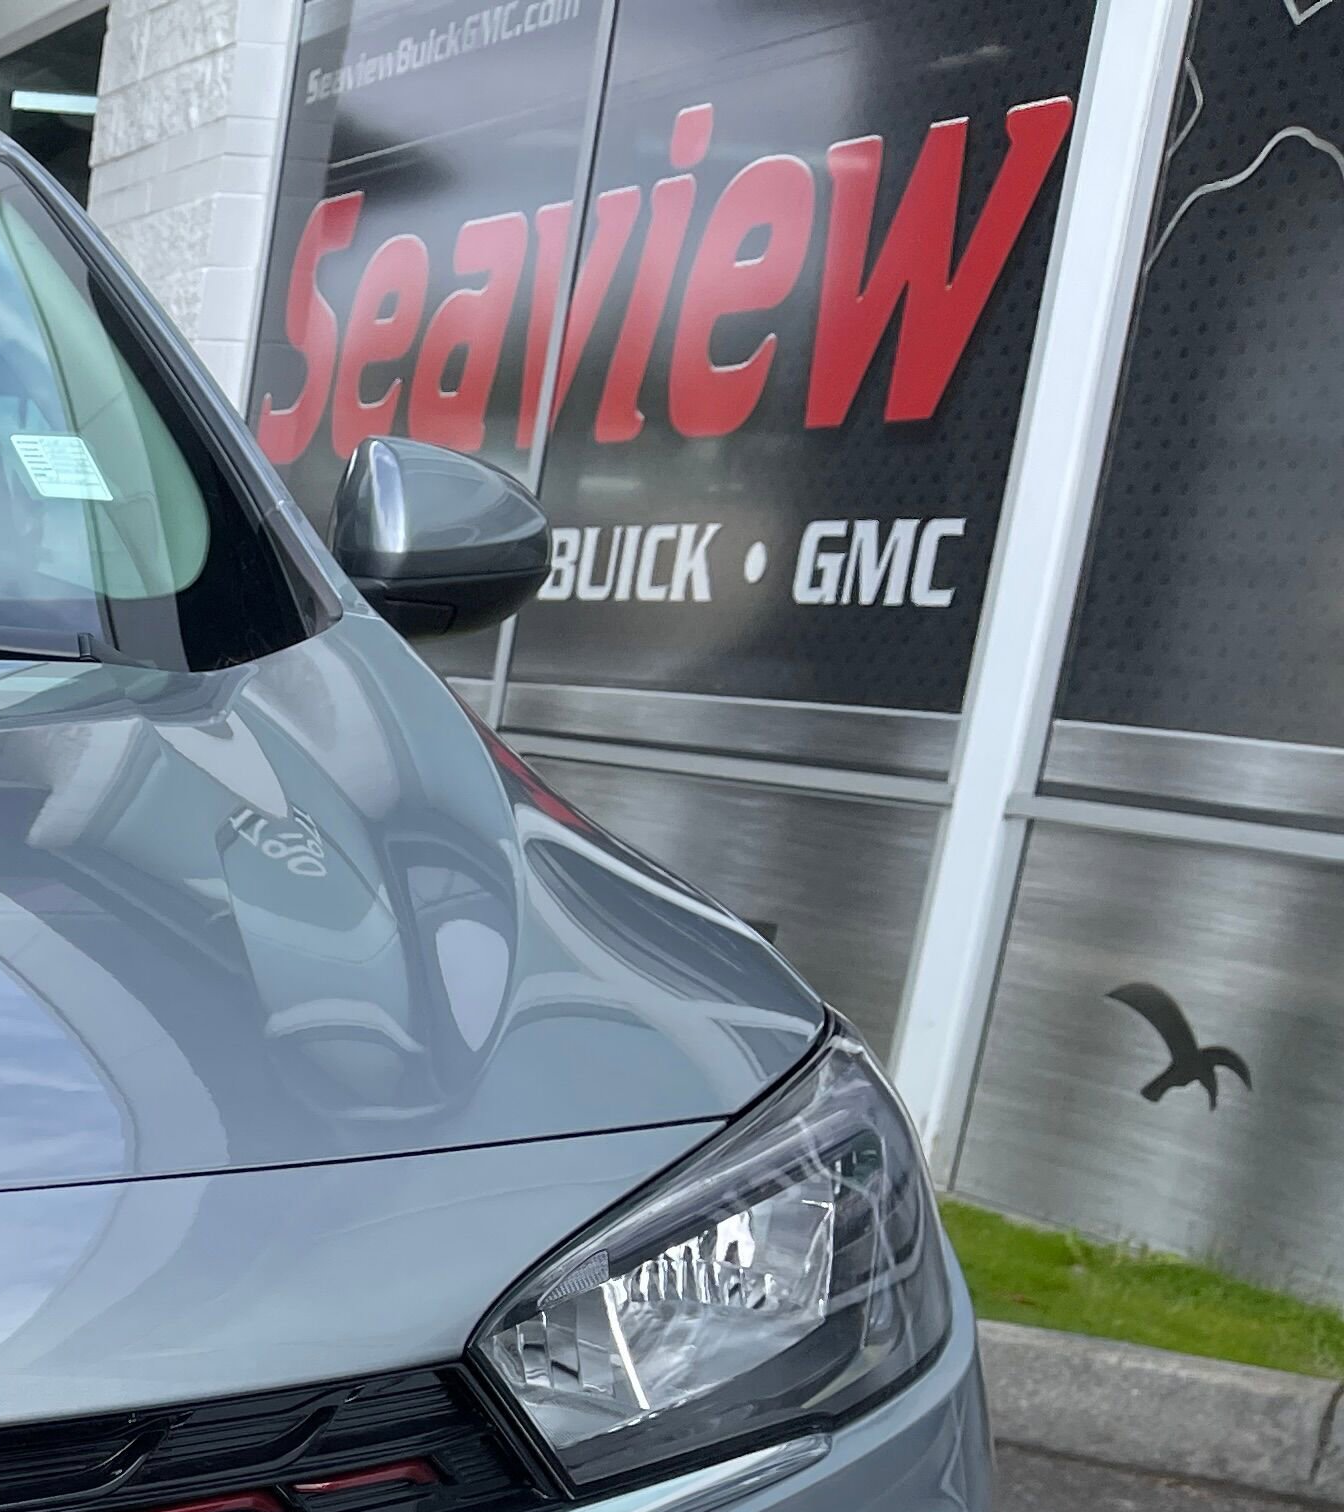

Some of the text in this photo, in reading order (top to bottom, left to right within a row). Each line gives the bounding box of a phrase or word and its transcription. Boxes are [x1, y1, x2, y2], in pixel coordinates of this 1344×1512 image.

[255, 96, 1073, 466] Seaview
[537, 518, 966, 607] BUICK GMC
